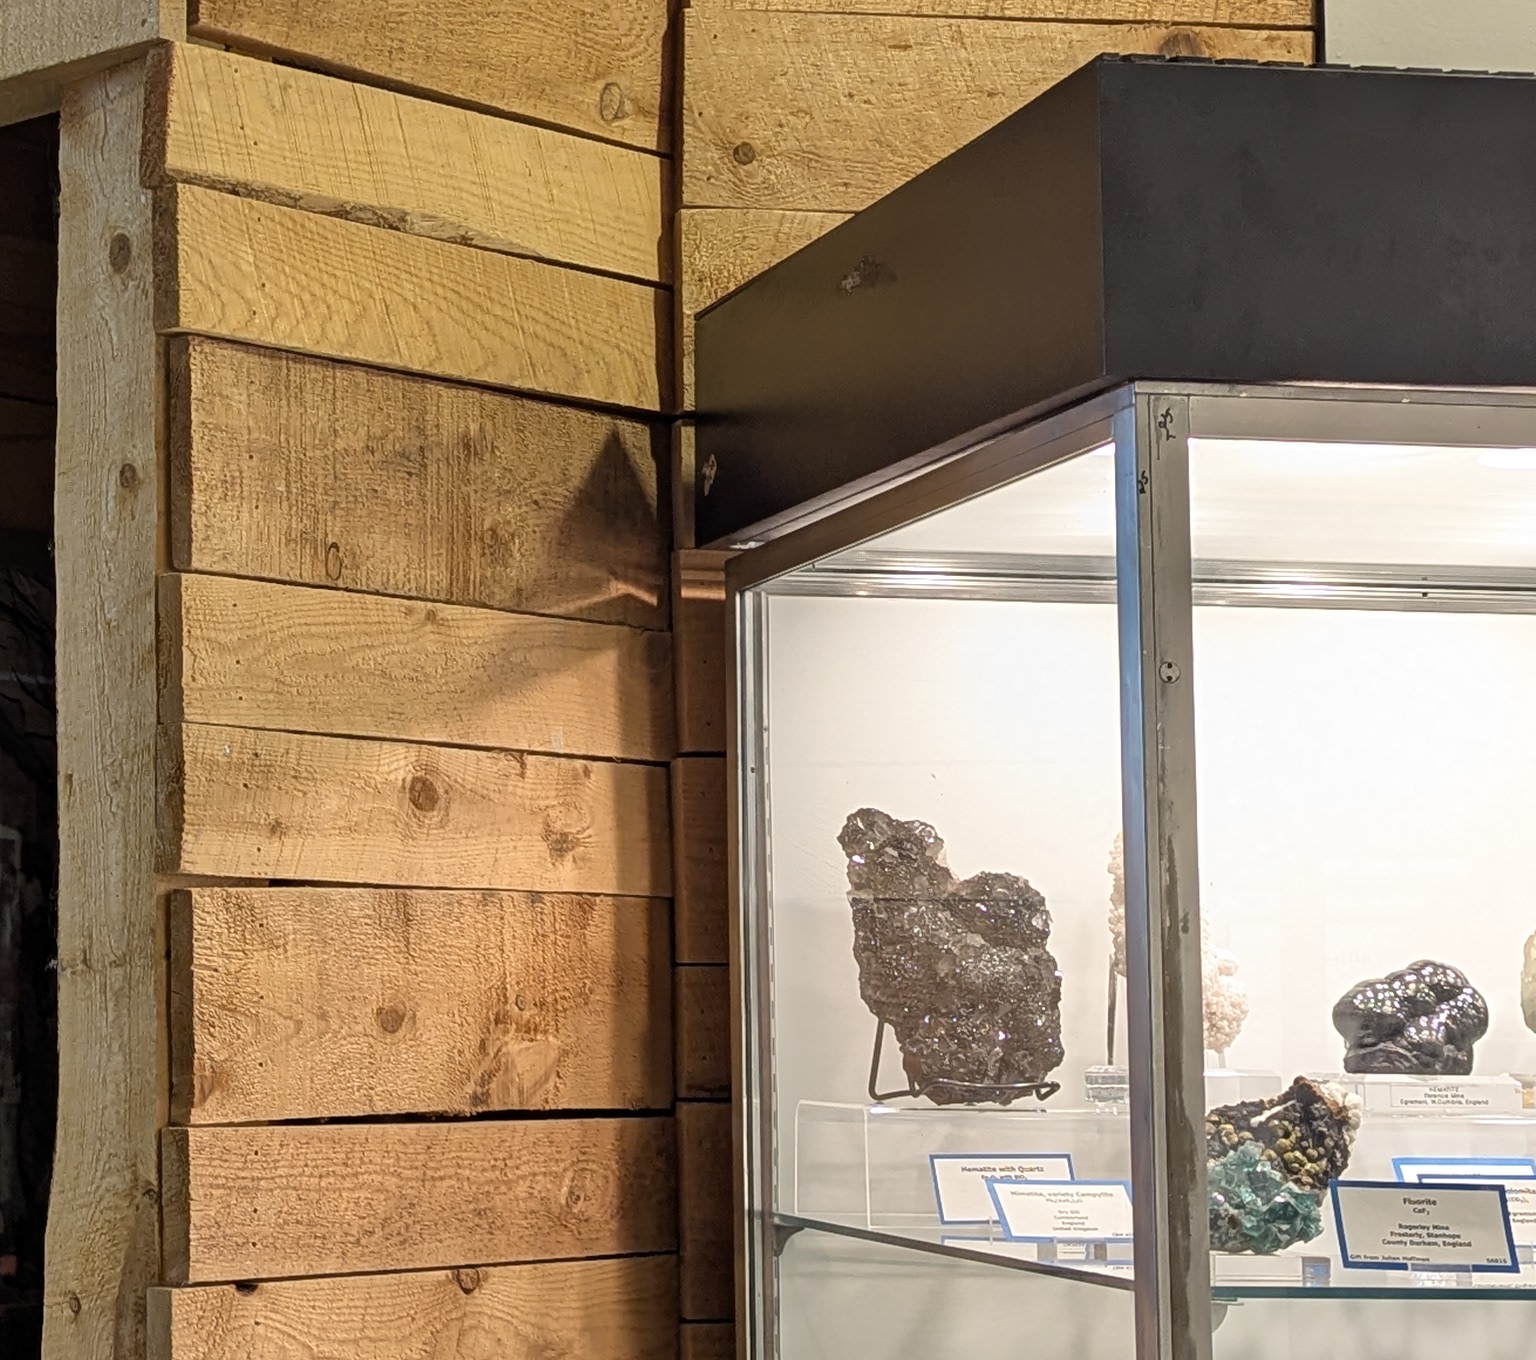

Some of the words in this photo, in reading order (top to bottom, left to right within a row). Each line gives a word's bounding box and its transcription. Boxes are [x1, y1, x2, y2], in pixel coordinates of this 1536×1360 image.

[961, 1166, 997, 1174] Hematite
[999, 1165, 1016, 1173] with
[1018, 1166, 1045, 1175] Quartz
[1402, 1197, 1437, 1206] Fluorite
[1426, 1232, 1461, 1240] Stanhope
[1382, 1238, 1408, 1247] County
[1409, 1239, 1441, 1248] Durham,
[1442, 1240, 1472, 1248] England
